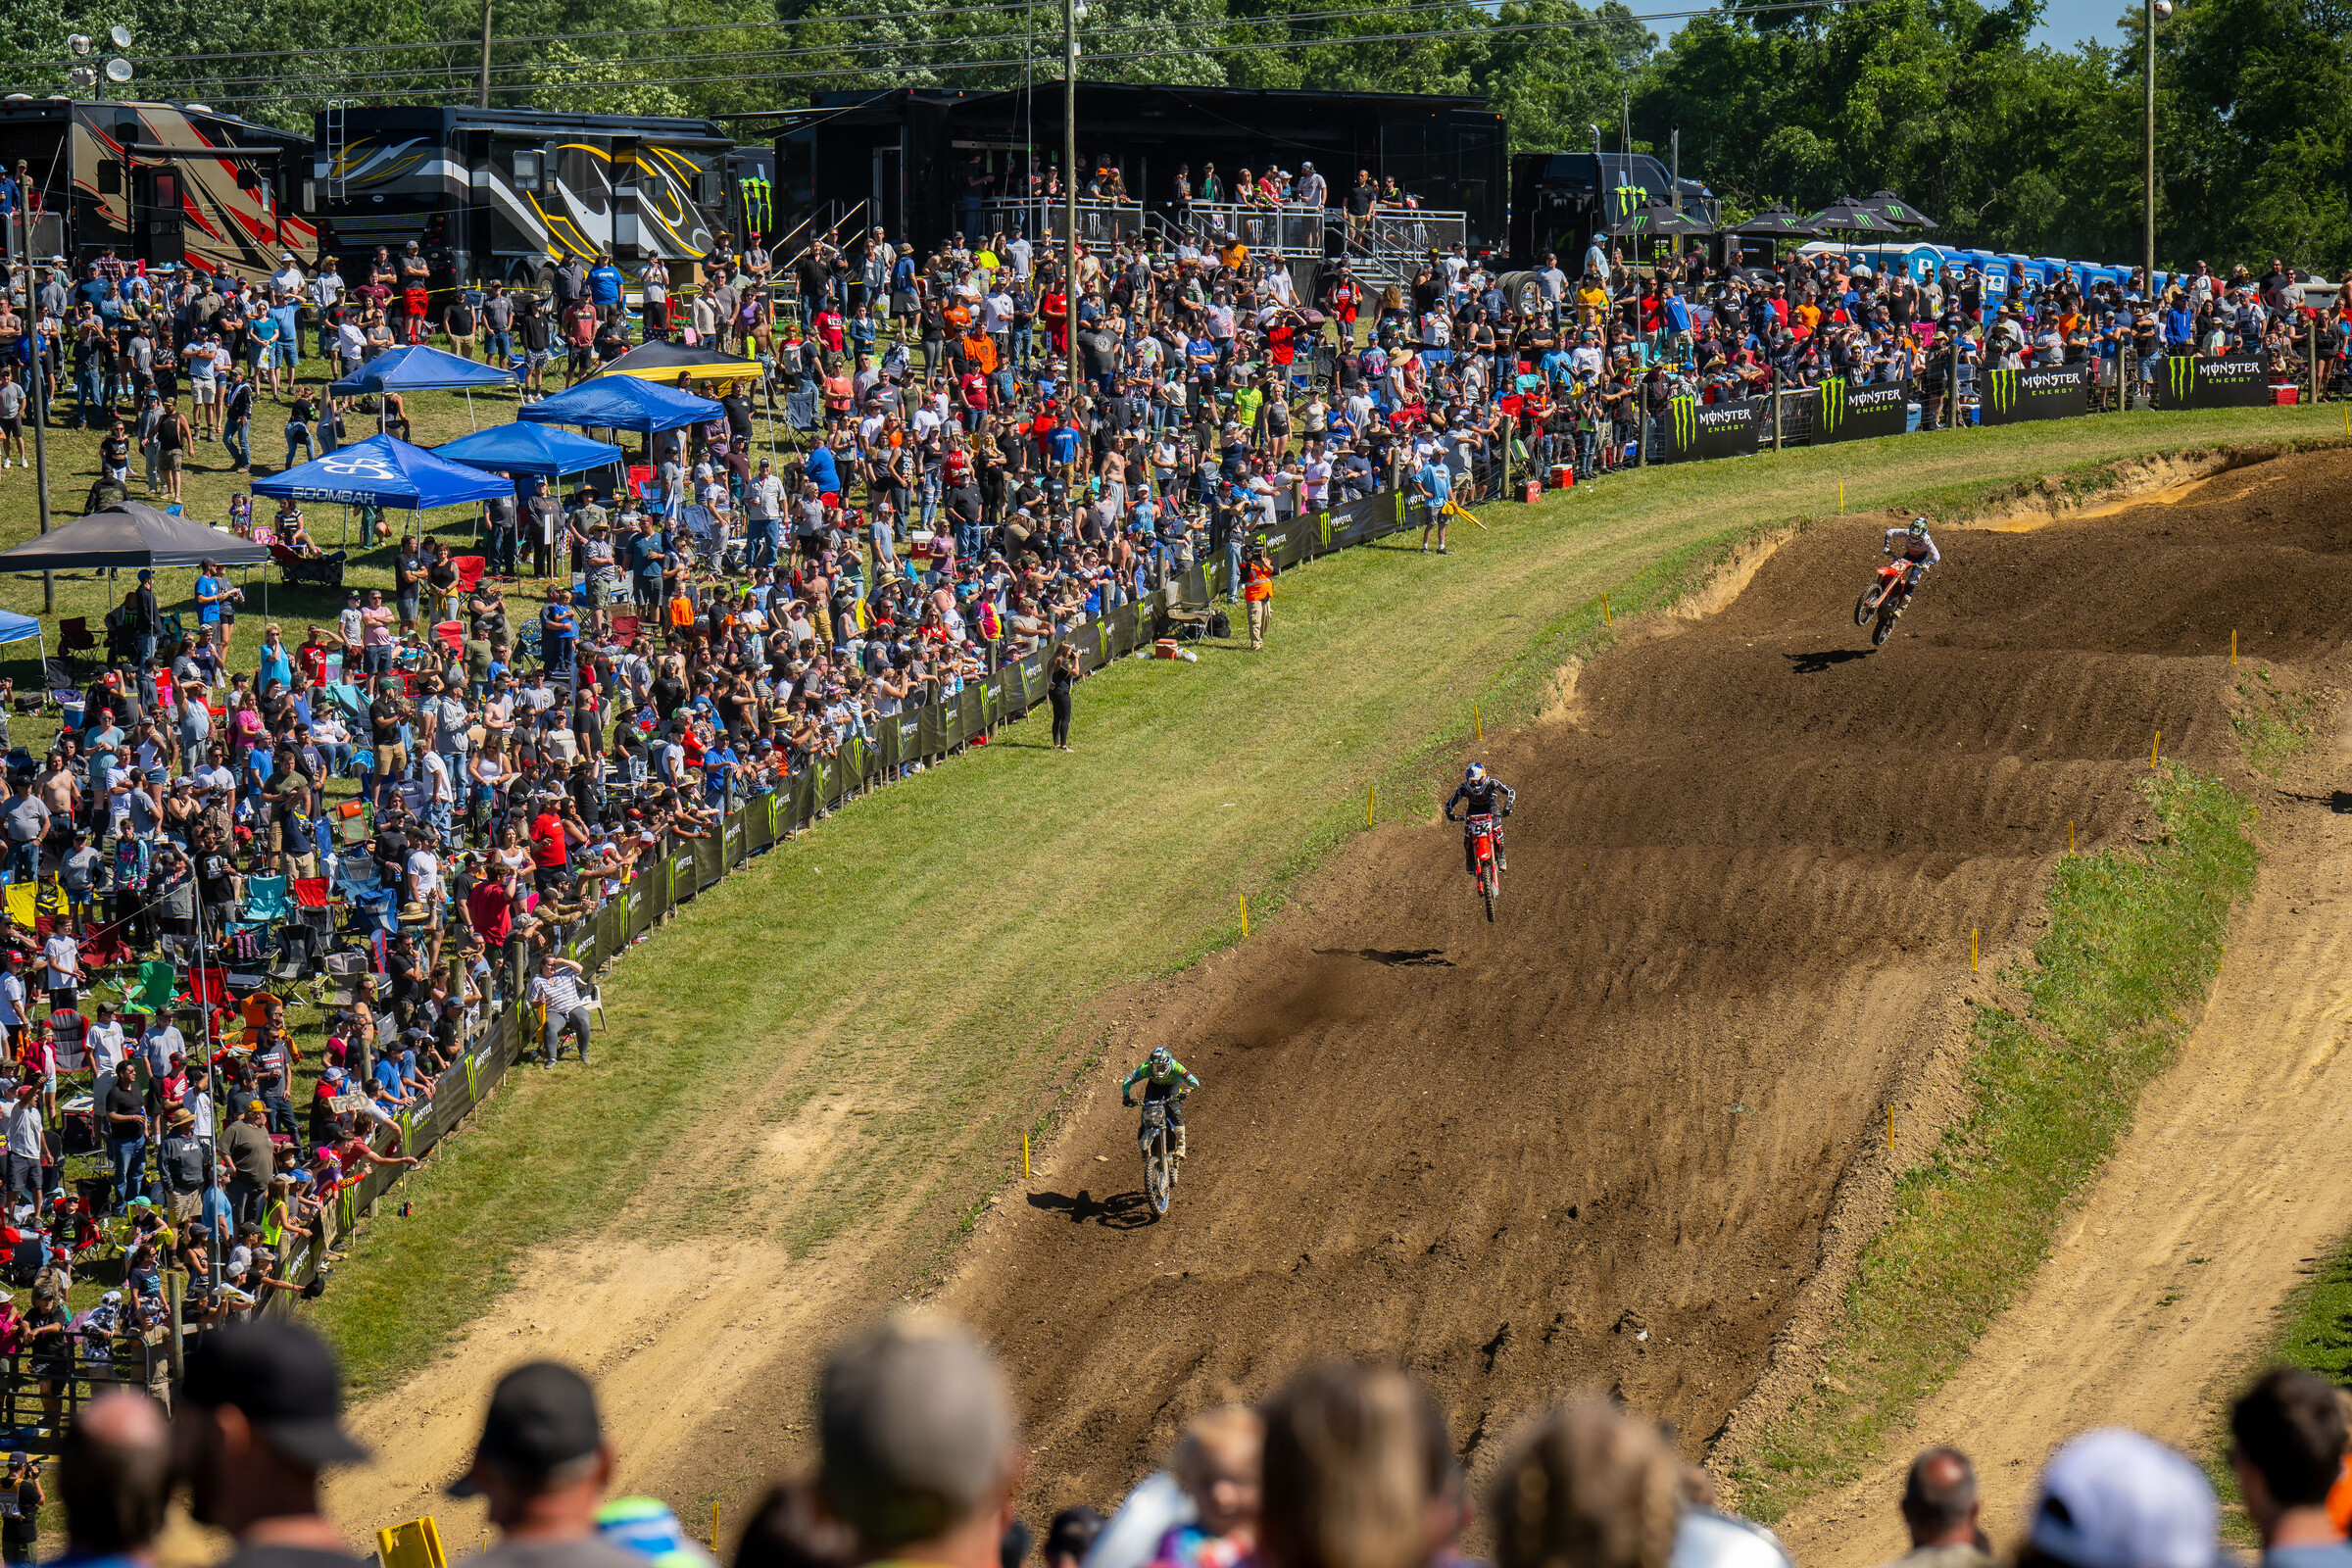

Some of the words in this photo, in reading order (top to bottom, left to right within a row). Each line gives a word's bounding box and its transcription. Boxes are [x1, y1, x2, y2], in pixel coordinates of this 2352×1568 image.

[2199, 362, 2261, 376] MONSTER
[2022, 372, 2081, 389] MONSTER
[1848, 389, 1901, 406] MONSTER
[2032, 387, 2073, 396] ENERGY
[1699, 409, 1752, 425] MONSTER
[1856, 404, 1894, 415] ENERGY
[1708, 423, 1745, 433] ENERGY
[291, 487, 376, 506] BOOMBAH
